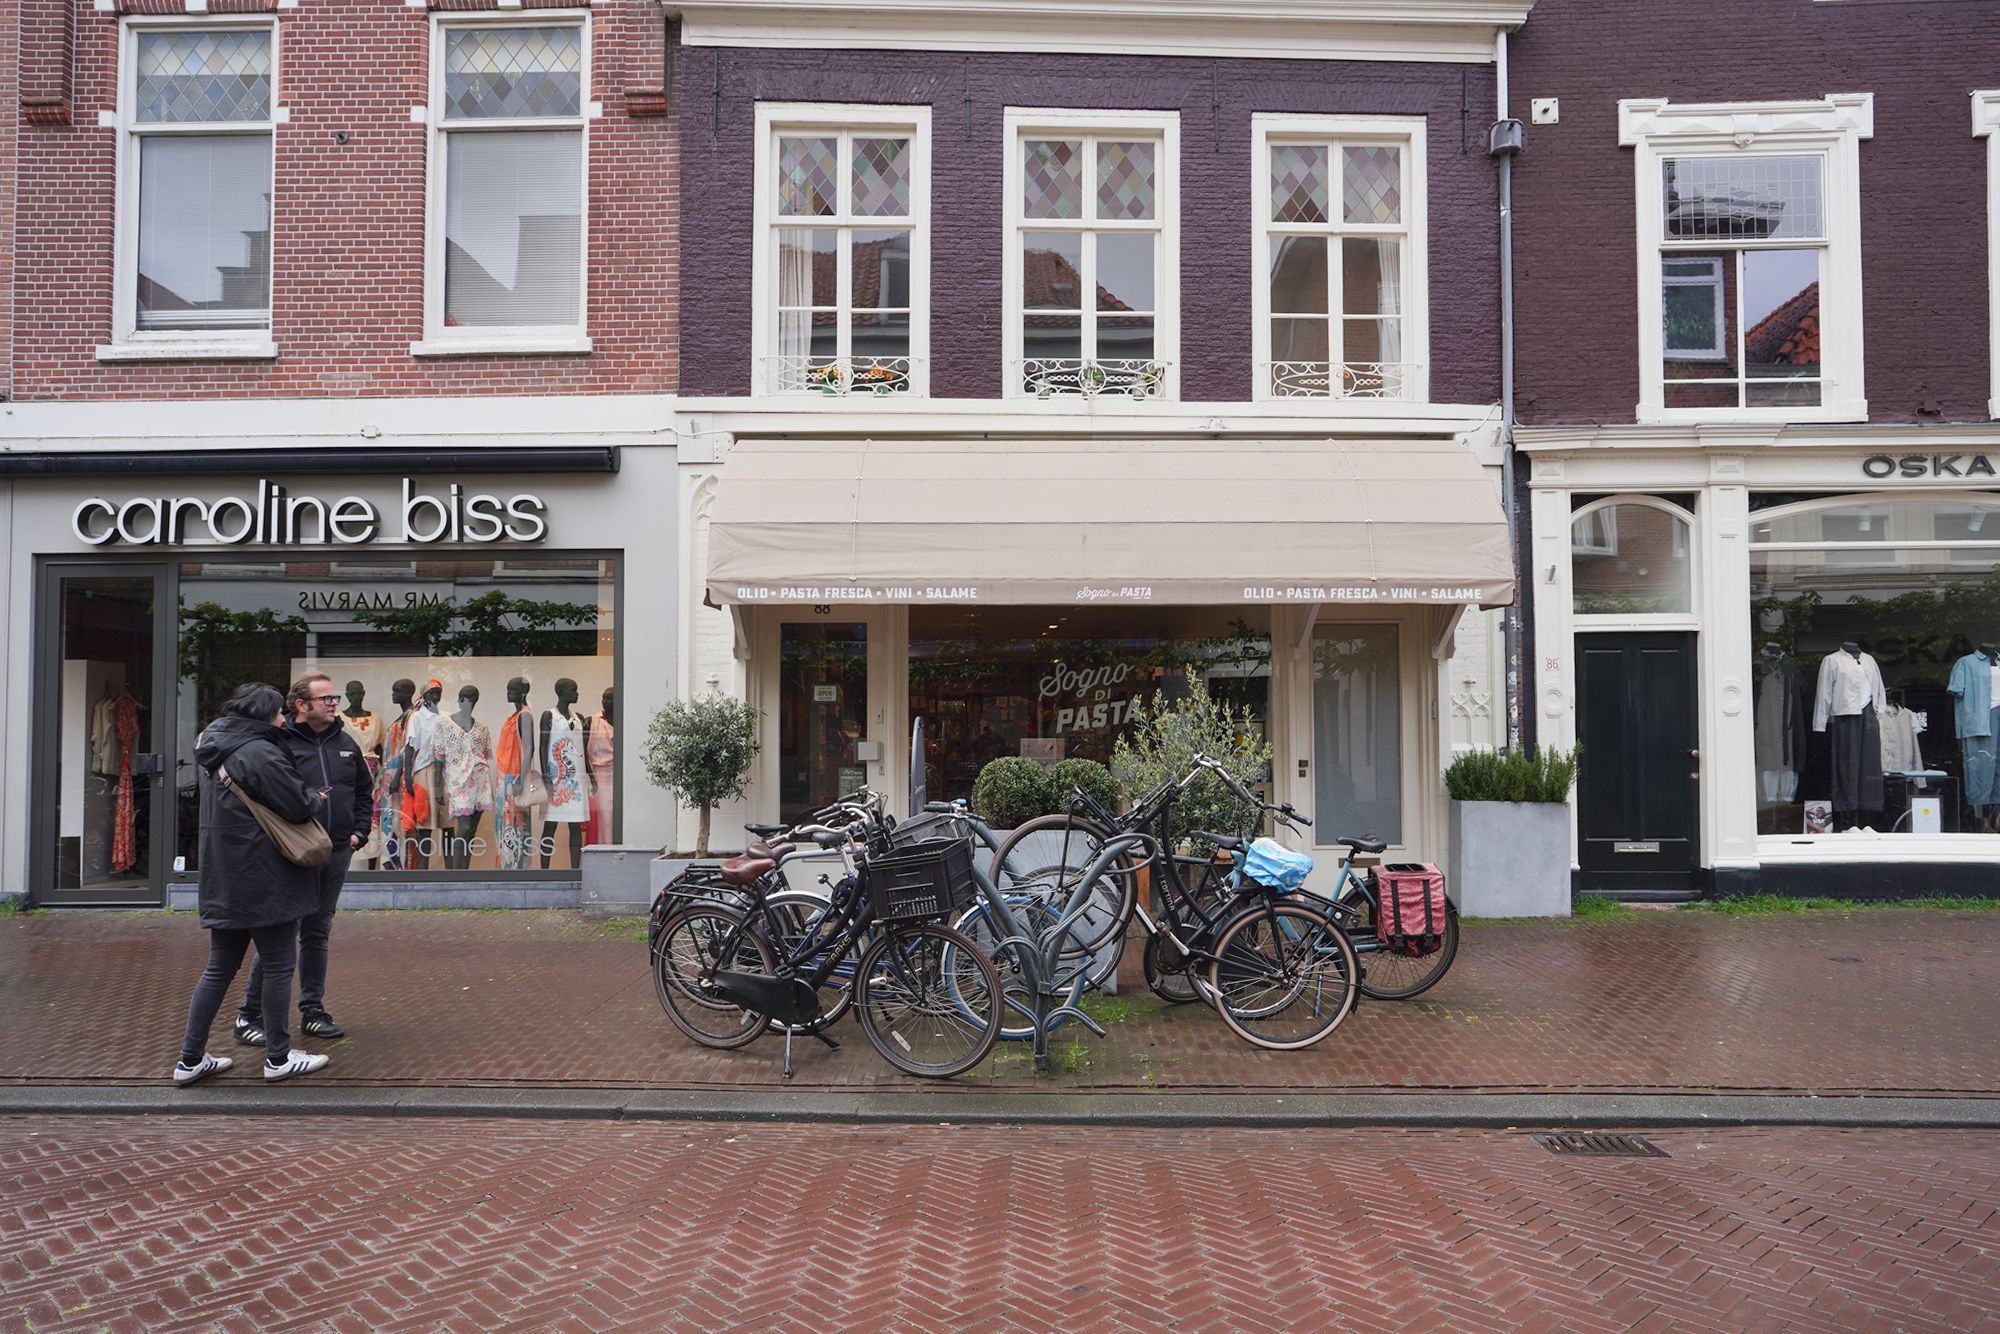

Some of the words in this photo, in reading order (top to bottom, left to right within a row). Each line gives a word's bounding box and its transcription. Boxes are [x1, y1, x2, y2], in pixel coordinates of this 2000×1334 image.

[1863, 455, 1997, 478] OSKA
[72, 478, 378, 544] caroline
[402, 477, 547, 543] biss
[737, 587, 768, 599] OLIO
[780, 587, 820, 599] PASTA
[825, 587, 873, 599] FRESCA
[885, 587, 912, 599] VINI
[926, 587, 977, 599] SALAME
[1076, 586, 1112, 600] Sogno
[1120, 587, 1152, 597] PASTA
[1244, 587, 1274, 599] OLIO
[1286, 587, 1326, 599] PASTA
[1330, 587, 1378, 599] FRESCA
[1391, 587, 1417, 599] VINI
[1430, 587, 1482, 599] SALAME
[1546, 658, 1558, 669] 86
[1039, 663, 1135, 701] Sogno
[1095, 689, 1111, 701] DI
[1056, 700, 1141, 734] PASTA
[371, 830, 487, 857] aroline
